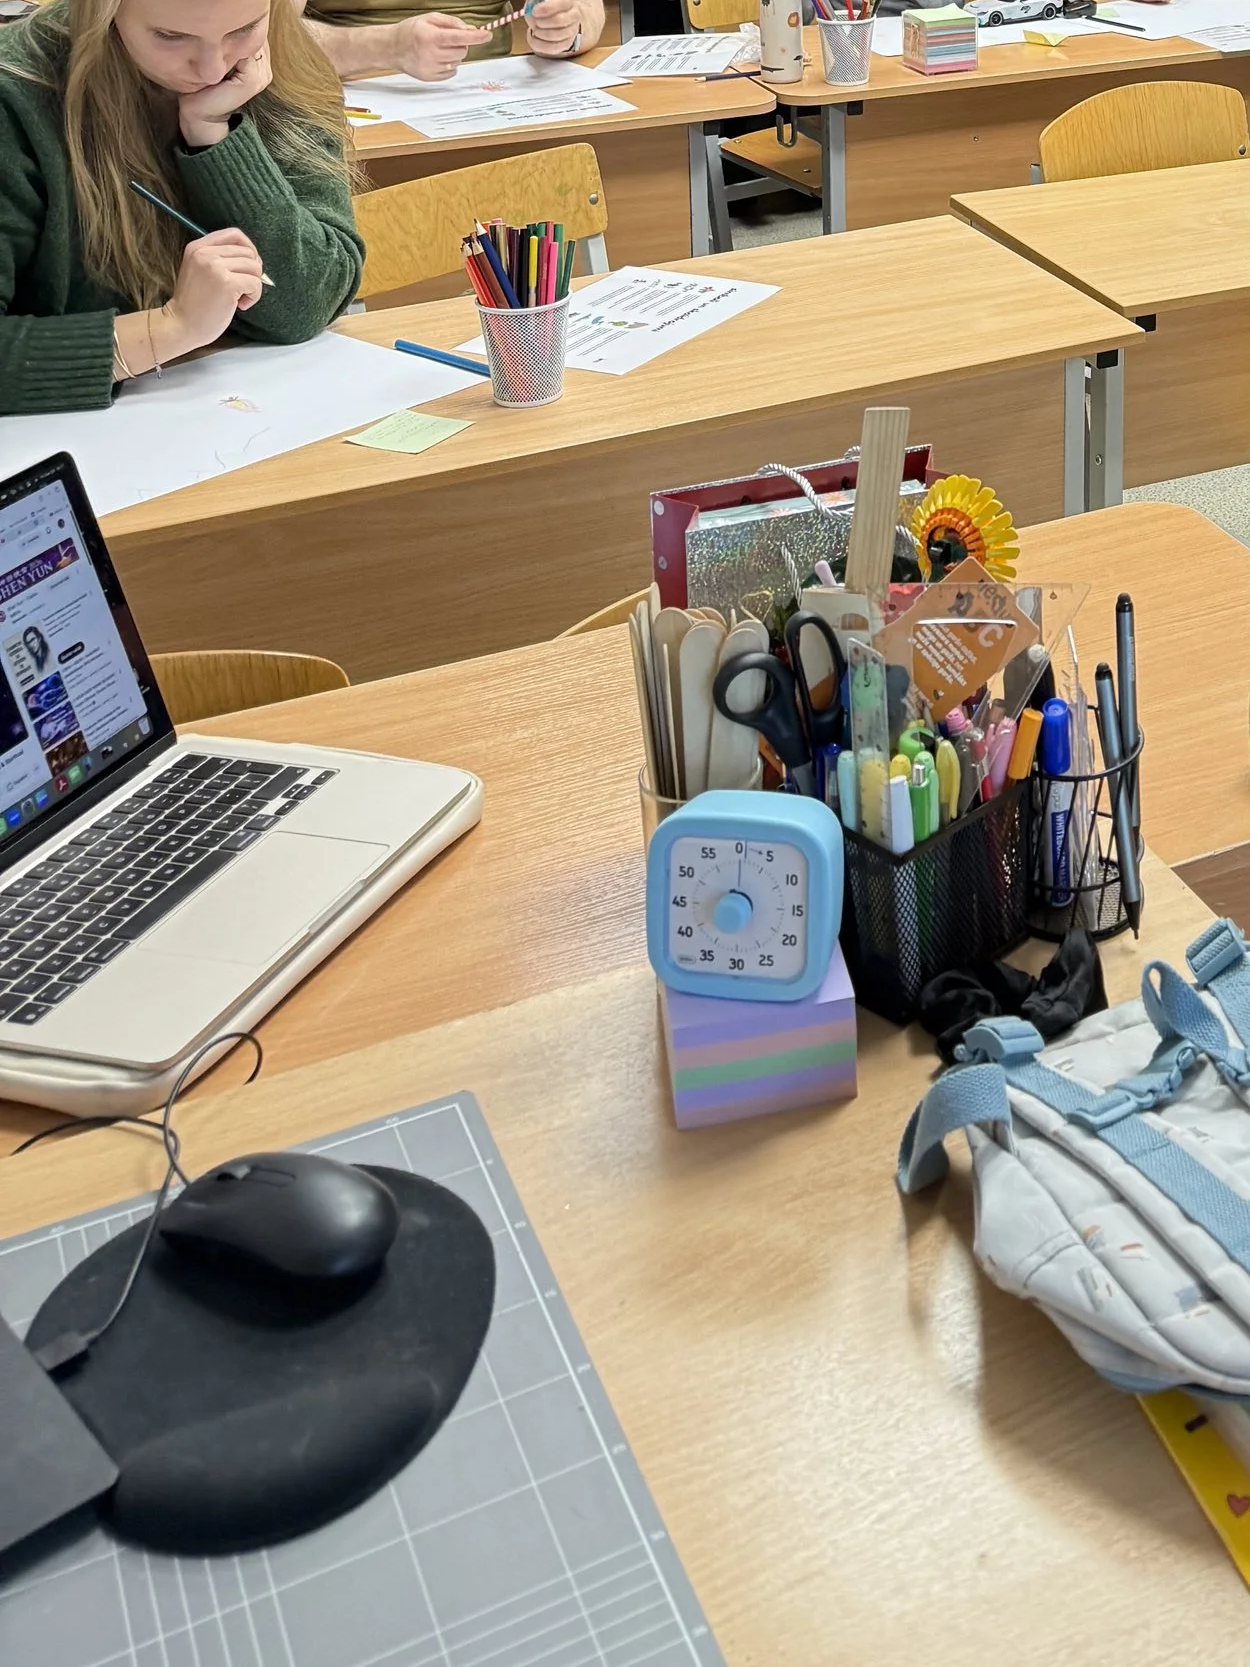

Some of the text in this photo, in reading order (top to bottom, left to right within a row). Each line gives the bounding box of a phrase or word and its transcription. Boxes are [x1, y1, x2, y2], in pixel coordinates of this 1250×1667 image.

[29, 562, 54, 583] YUN
[701, 847, 716, 859] 55
[735, 842, 743, 854] 0
[766, 850, 774, 862] 5
[678, 866, 694, 878] 50
[786, 874, 798, 886] 10
[672, 896, 687, 907] 45
[792, 905, 804, 917] 15
[677, 926, 693, 937] 40
[782, 934, 797, 946] 20
[700, 950, 715, 962] 35
[759, 954, 774, 967] 25
[728, 958, 744, 970] 30
